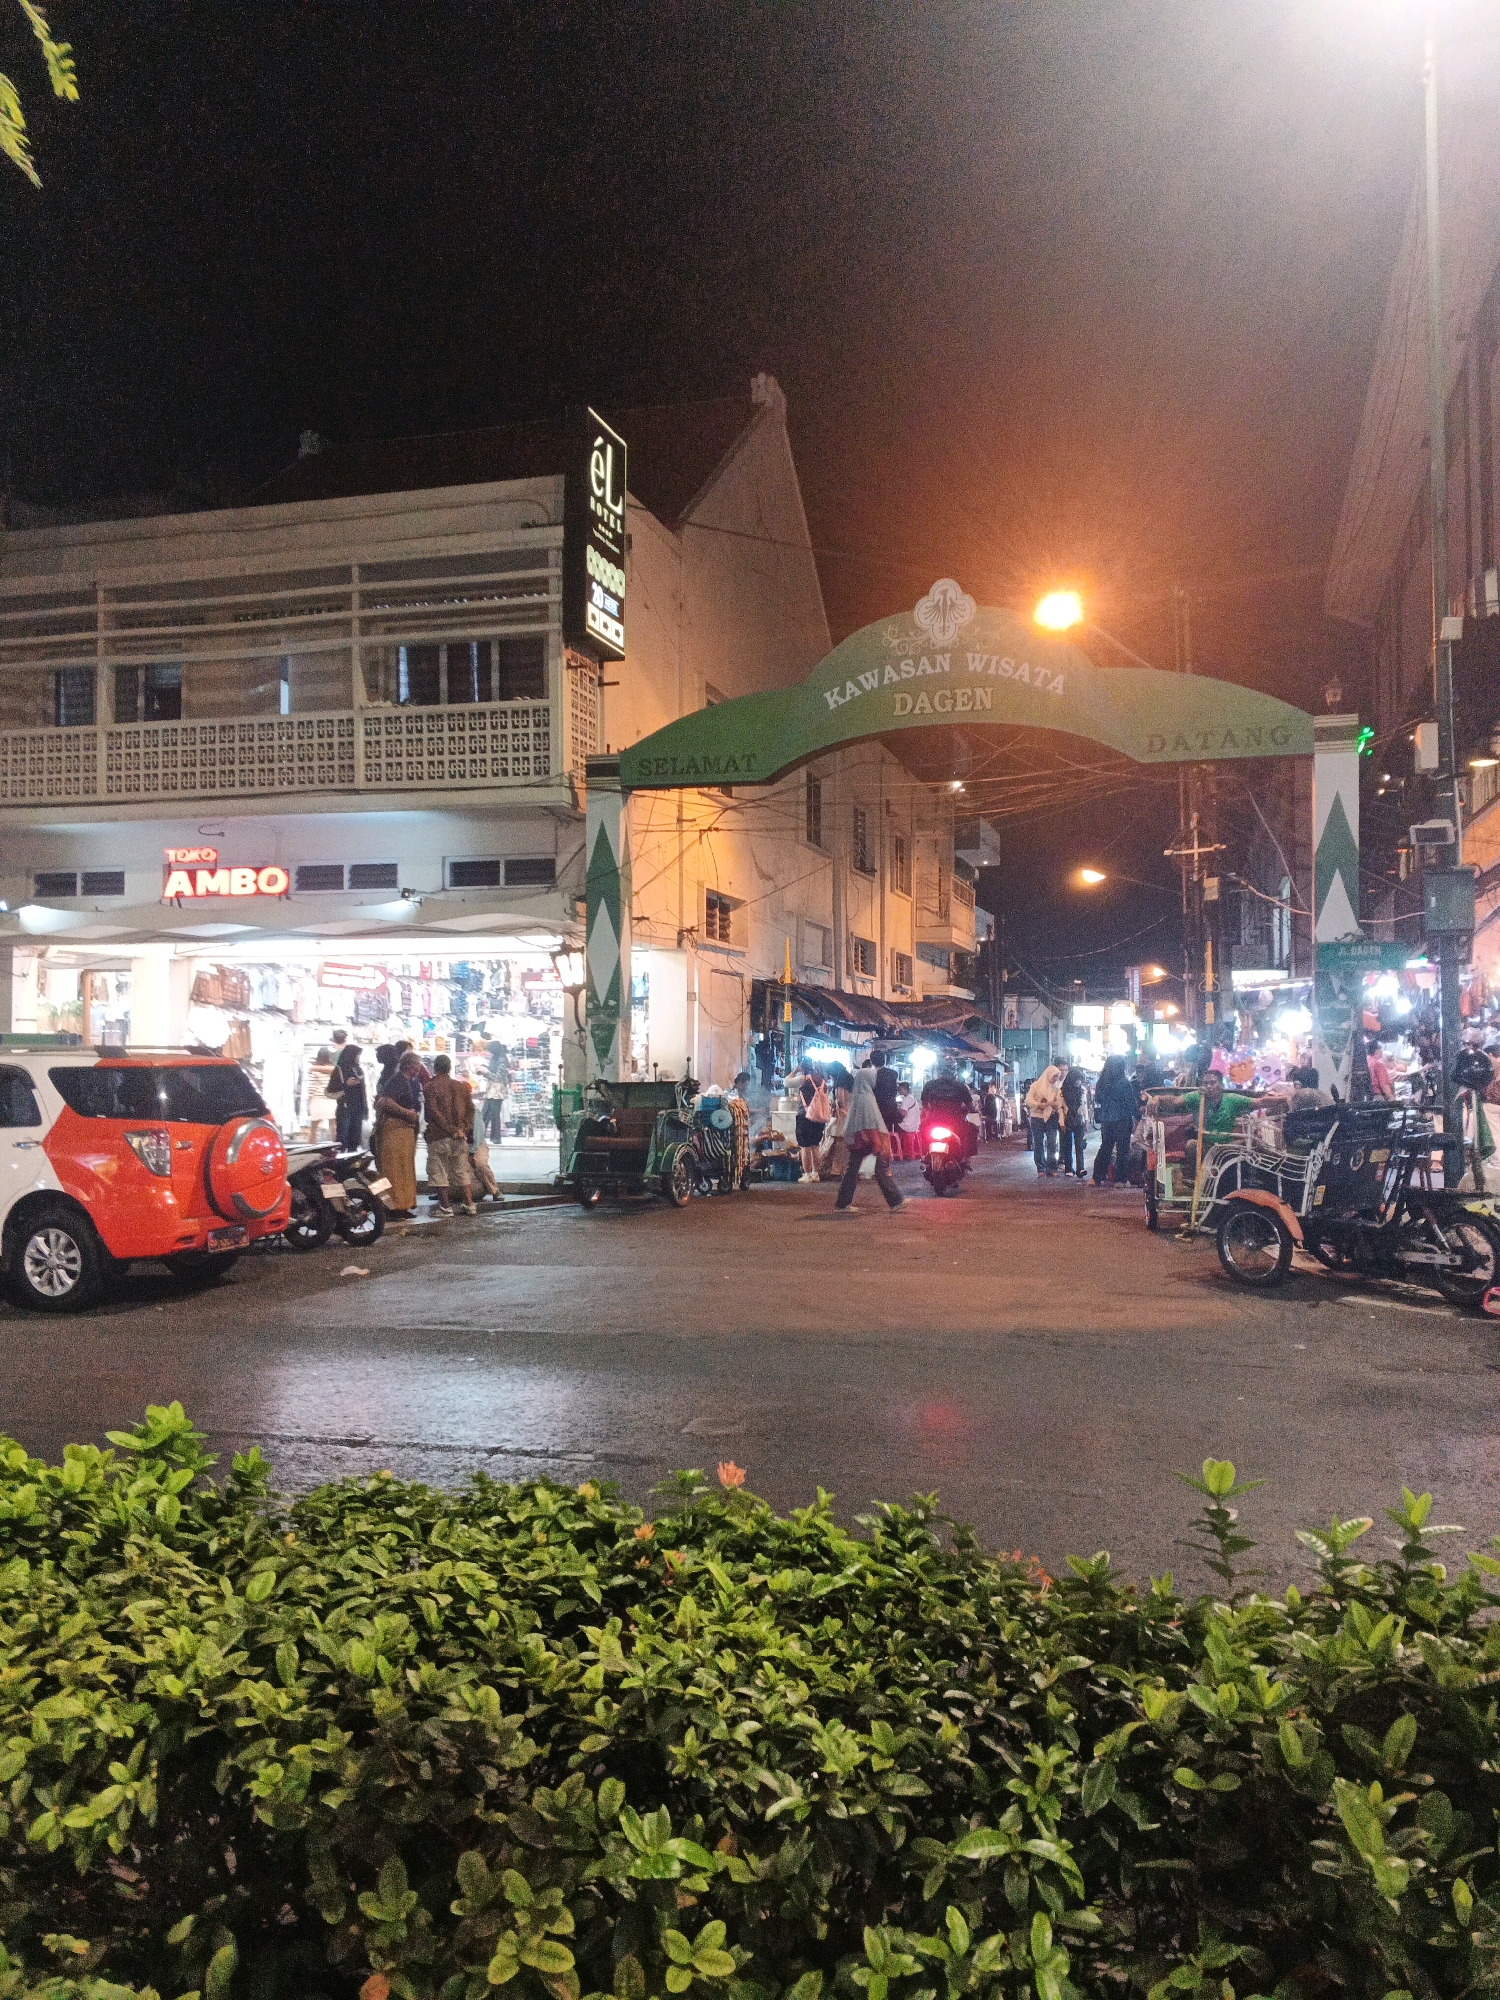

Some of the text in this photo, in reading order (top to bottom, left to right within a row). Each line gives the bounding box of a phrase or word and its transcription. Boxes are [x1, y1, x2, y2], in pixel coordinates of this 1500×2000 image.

[590, 495, 623, 533] HOTEL
[823, 651, 1065, 710] KAWASAN WISATA
[893, 686, 996, 716] DAGEN
[1147, 725, 1293, 753] DATANG
[639, 751, 758, 777] SELAMAT
[163, 846, 218, 863] TOKO
[162, 866, 290, 899] AMBO
